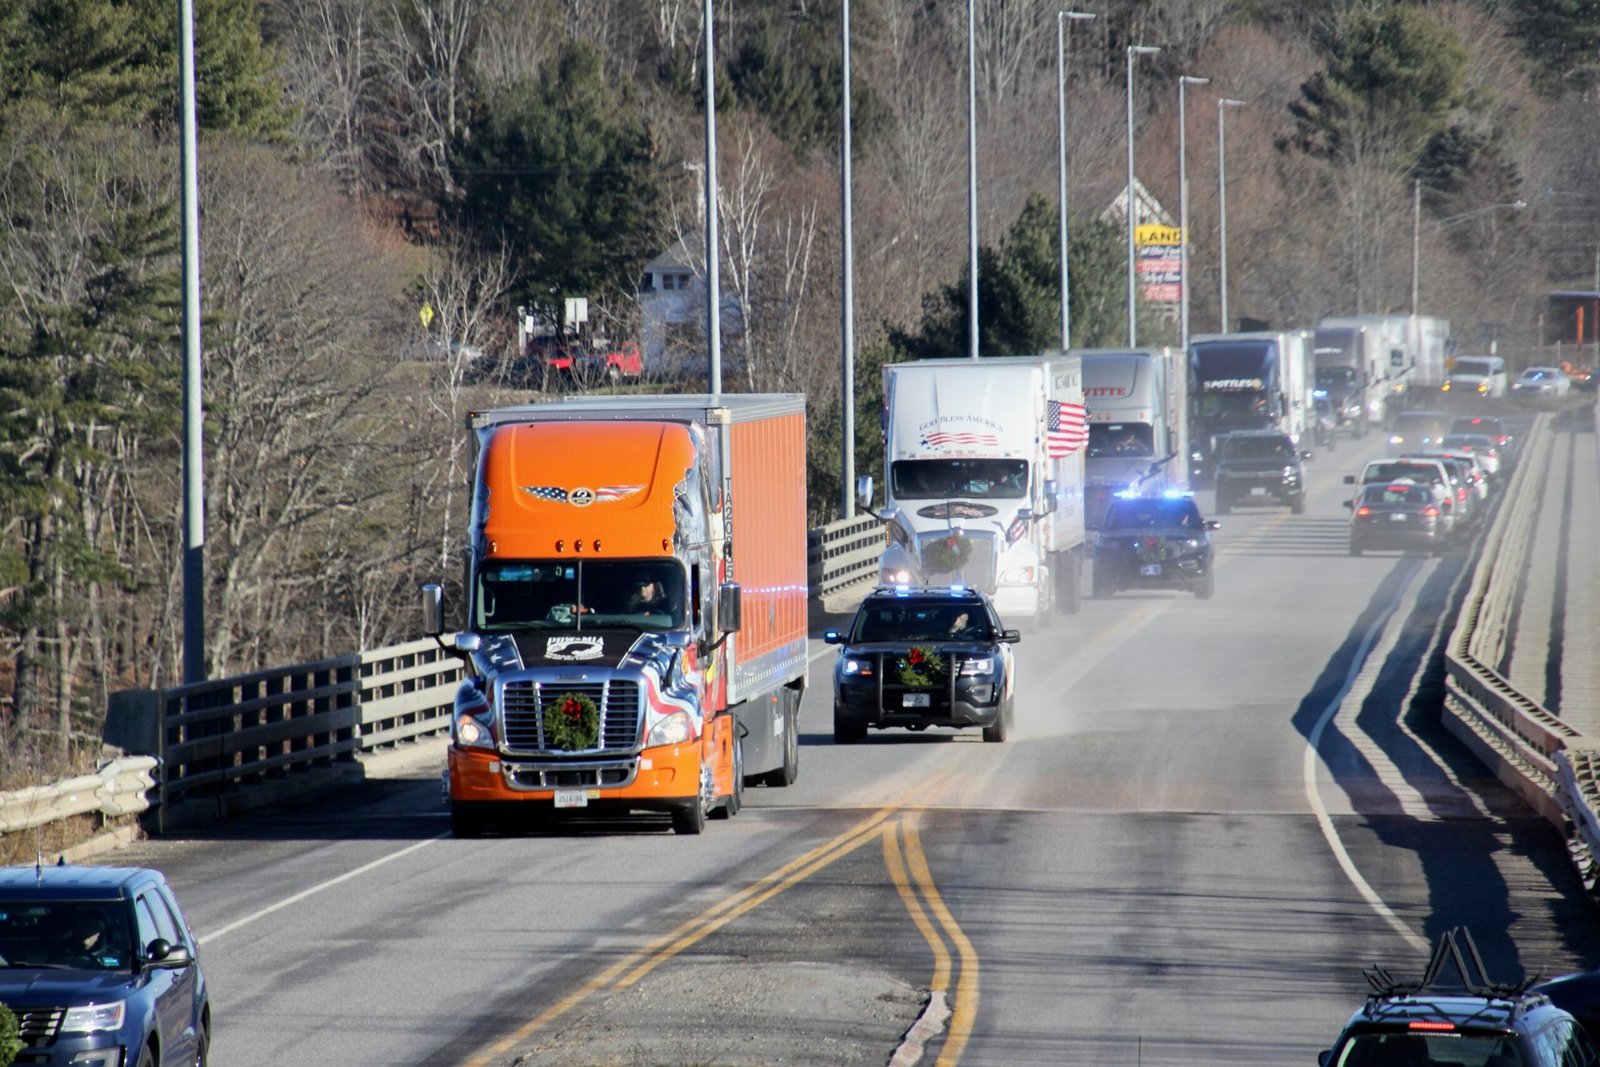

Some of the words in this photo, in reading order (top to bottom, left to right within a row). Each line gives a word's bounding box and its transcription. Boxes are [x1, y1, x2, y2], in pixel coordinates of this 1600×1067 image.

[919, 419, 938, 431] GOD
[940, 415, 964, 423] BLESS
[967, 415, 1004, 432] AMERICA
